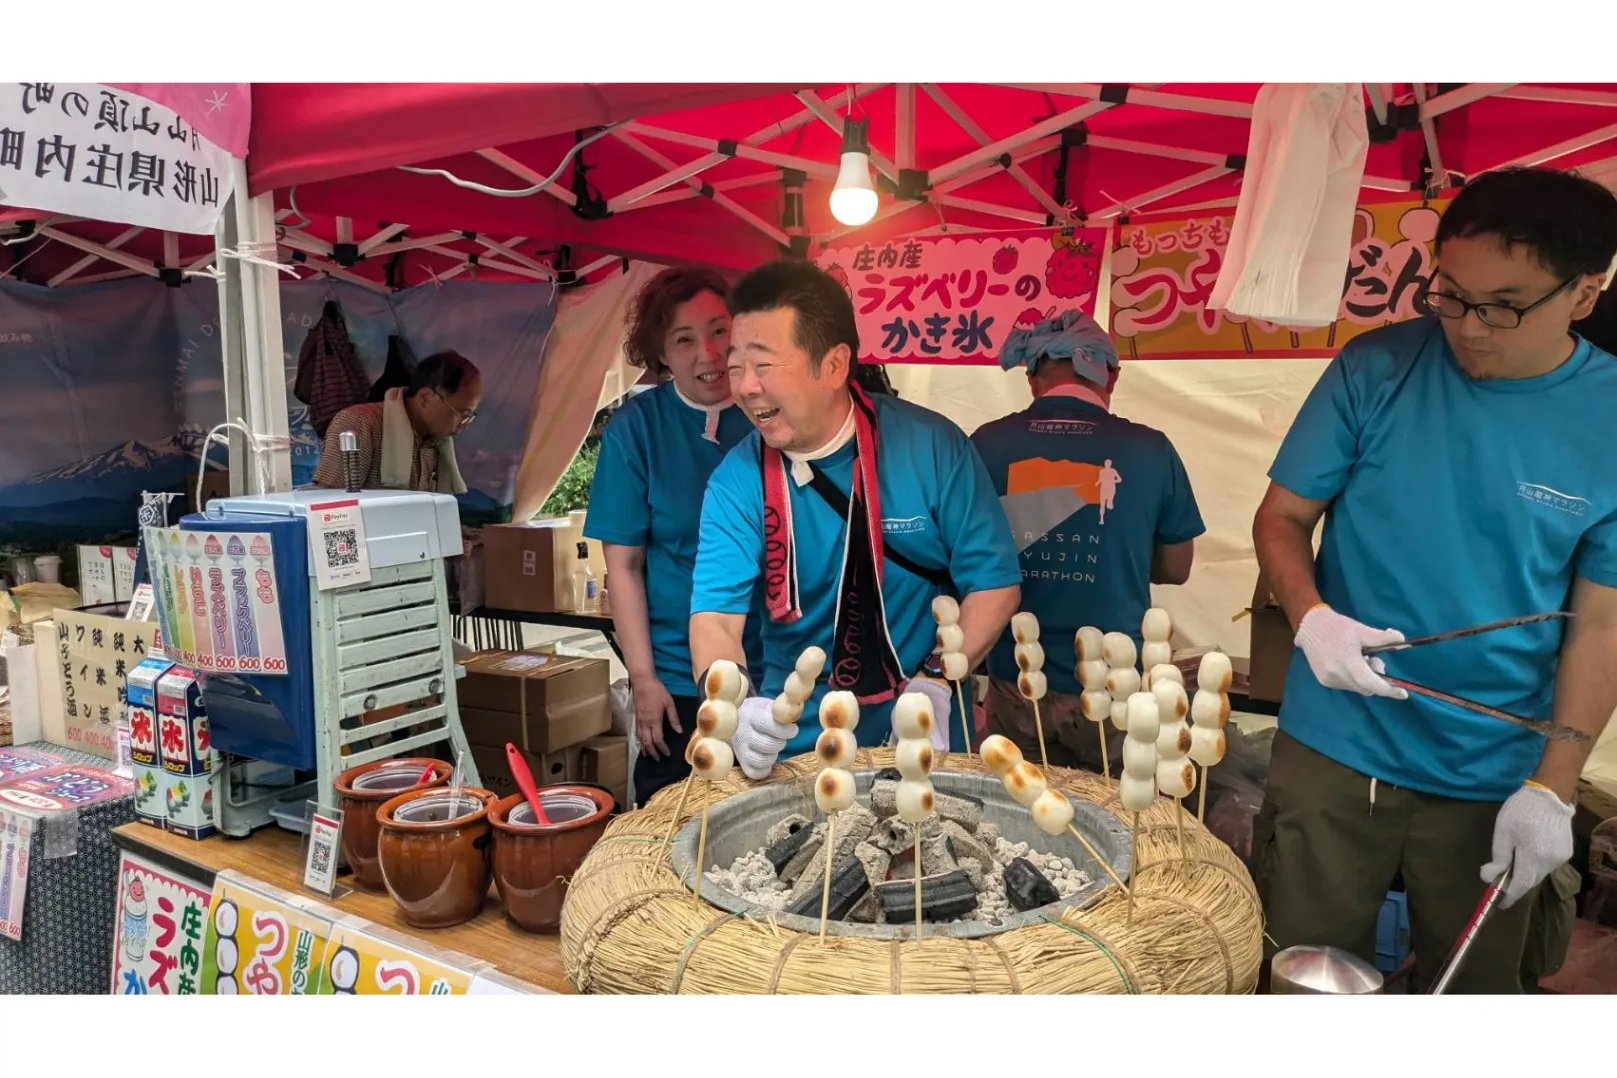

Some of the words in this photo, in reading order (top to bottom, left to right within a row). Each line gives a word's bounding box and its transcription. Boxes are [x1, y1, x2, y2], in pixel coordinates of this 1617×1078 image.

[1131, 218, 1231, 252] もっちも
[852, 241, 923, 271] 庄内産
[857, 269, 1042, 315] ラズベリーの
[881, 310, 995, 354] かき氷
[1011, 530, 1100, 545] ASSAN
[1023, 551, 1098, 565] YUJIN
[1018, 569, 1096, 585] ARATHON
[197, 653, 214, 667] 400
[216, 655, 236, 669] 600
[239, 658, 260, 670] 600
[264, 659, 286, 671] 600
[130, 711, 153, 745] 氷
[161, 719, 185, 753] 氷
[291, 930, 313, 994] 山形の
